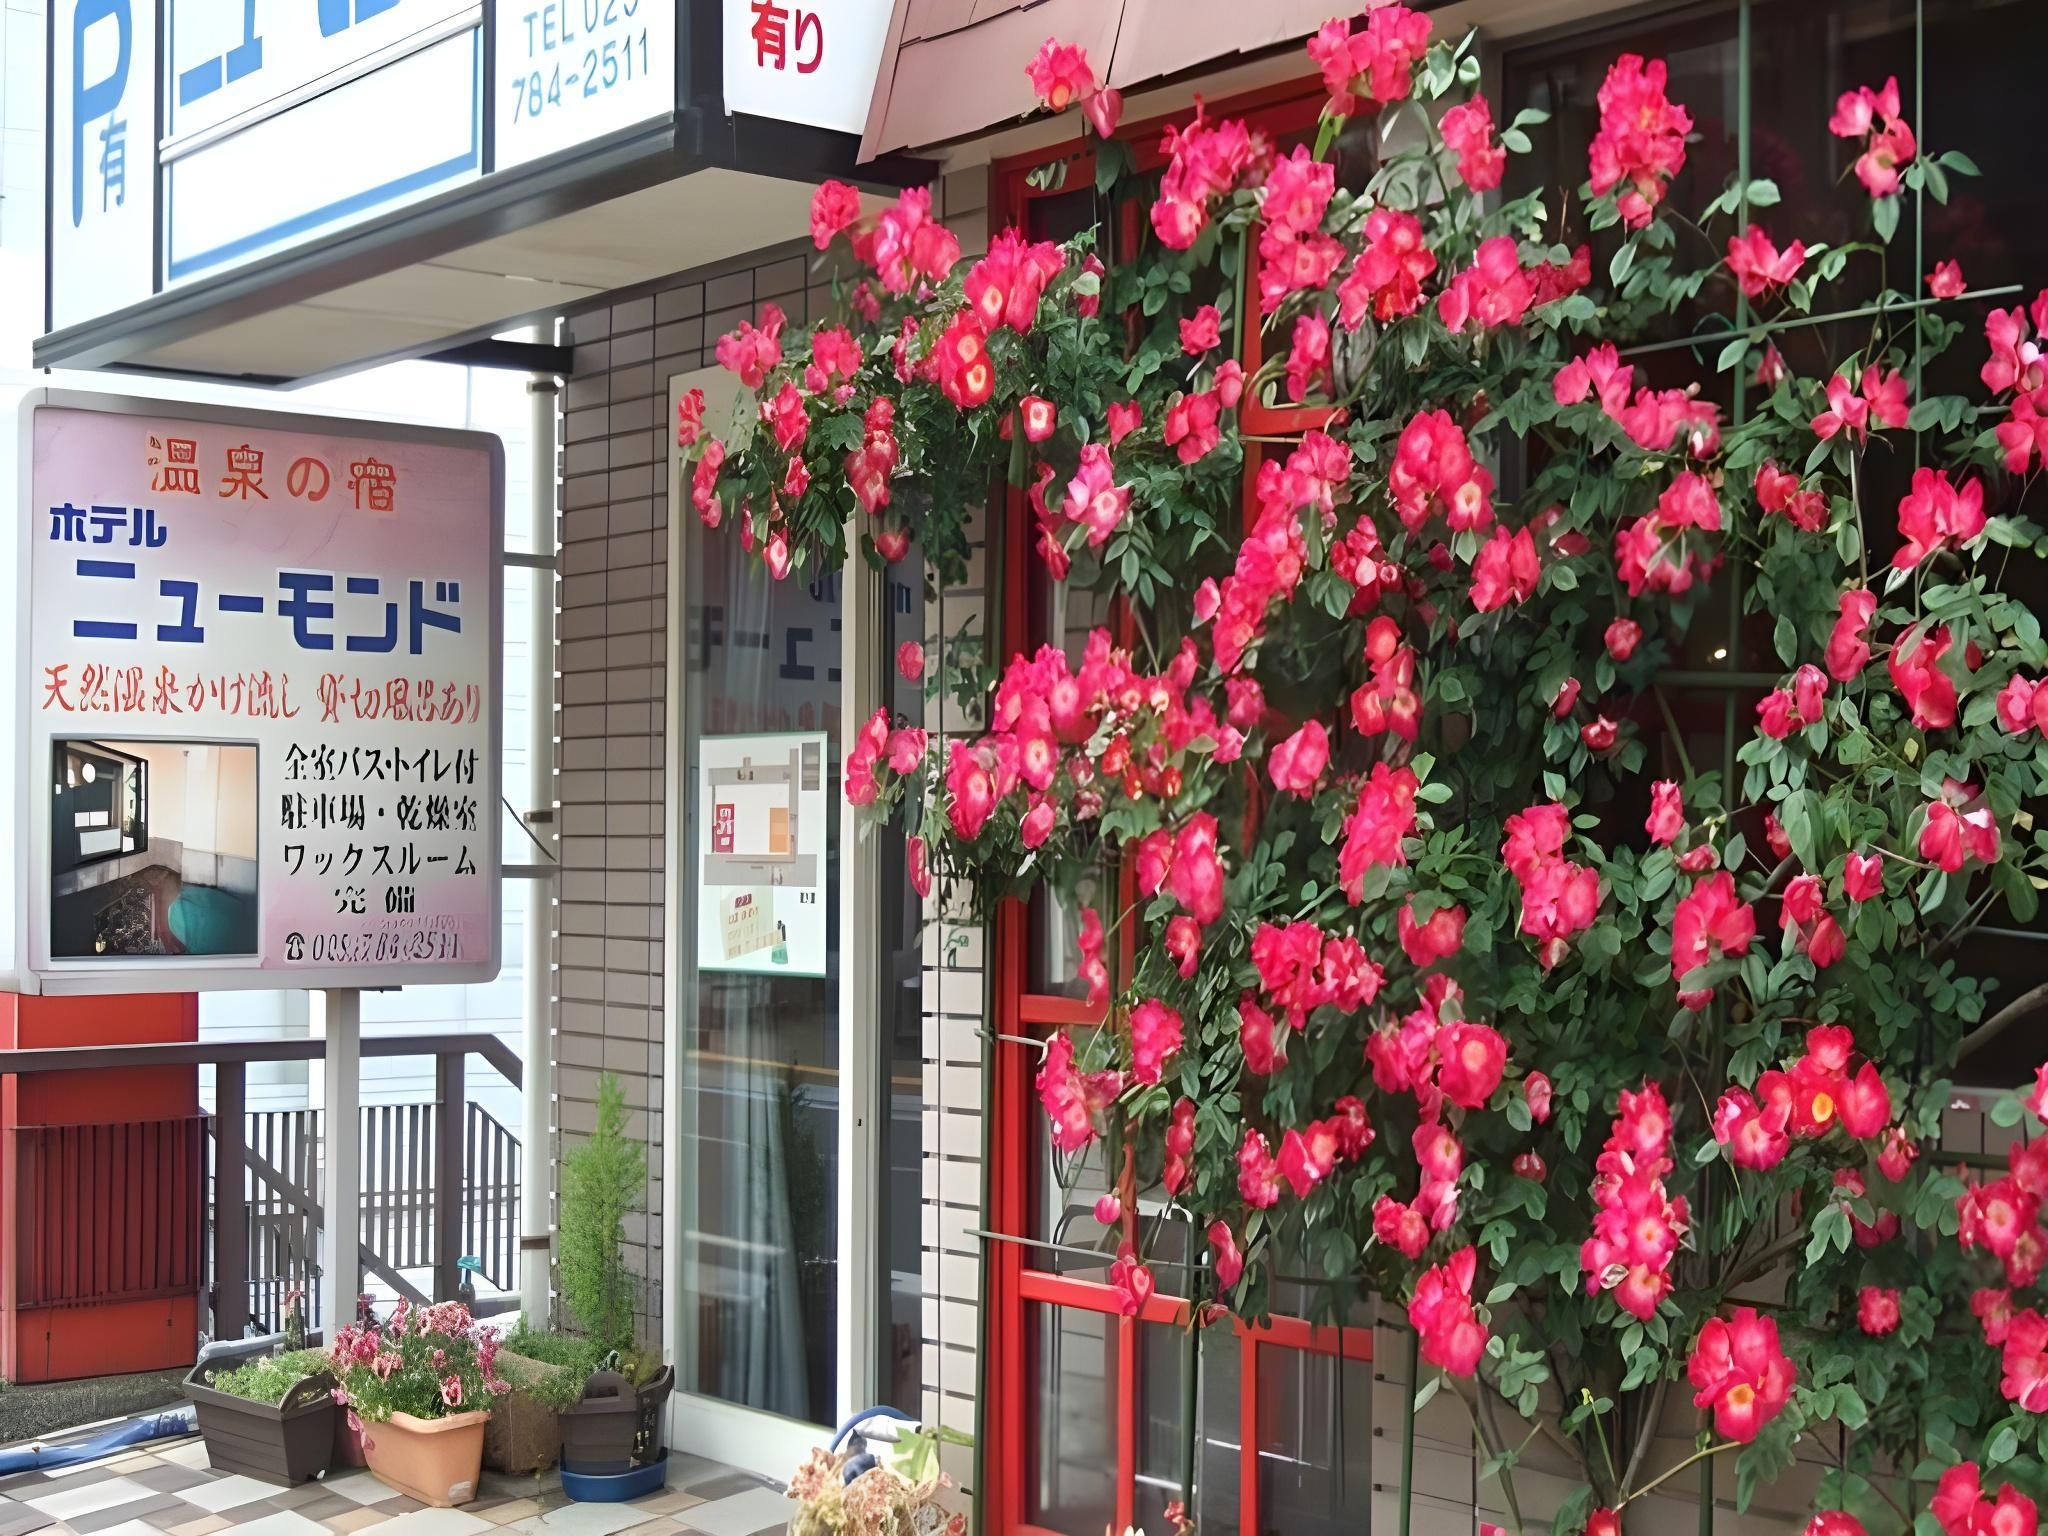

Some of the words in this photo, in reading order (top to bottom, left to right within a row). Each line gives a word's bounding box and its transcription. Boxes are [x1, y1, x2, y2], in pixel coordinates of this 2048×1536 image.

[522, 0, 576, 58] TEL
[751, 0, 824, 74] 有り
[511, 27, 649, 125] 784-2511
[49, 502, 168, 548] ホテル
[73, 559, 462, 655] ニューモンド
[284, 842, 477, 876] ワックスルーム
